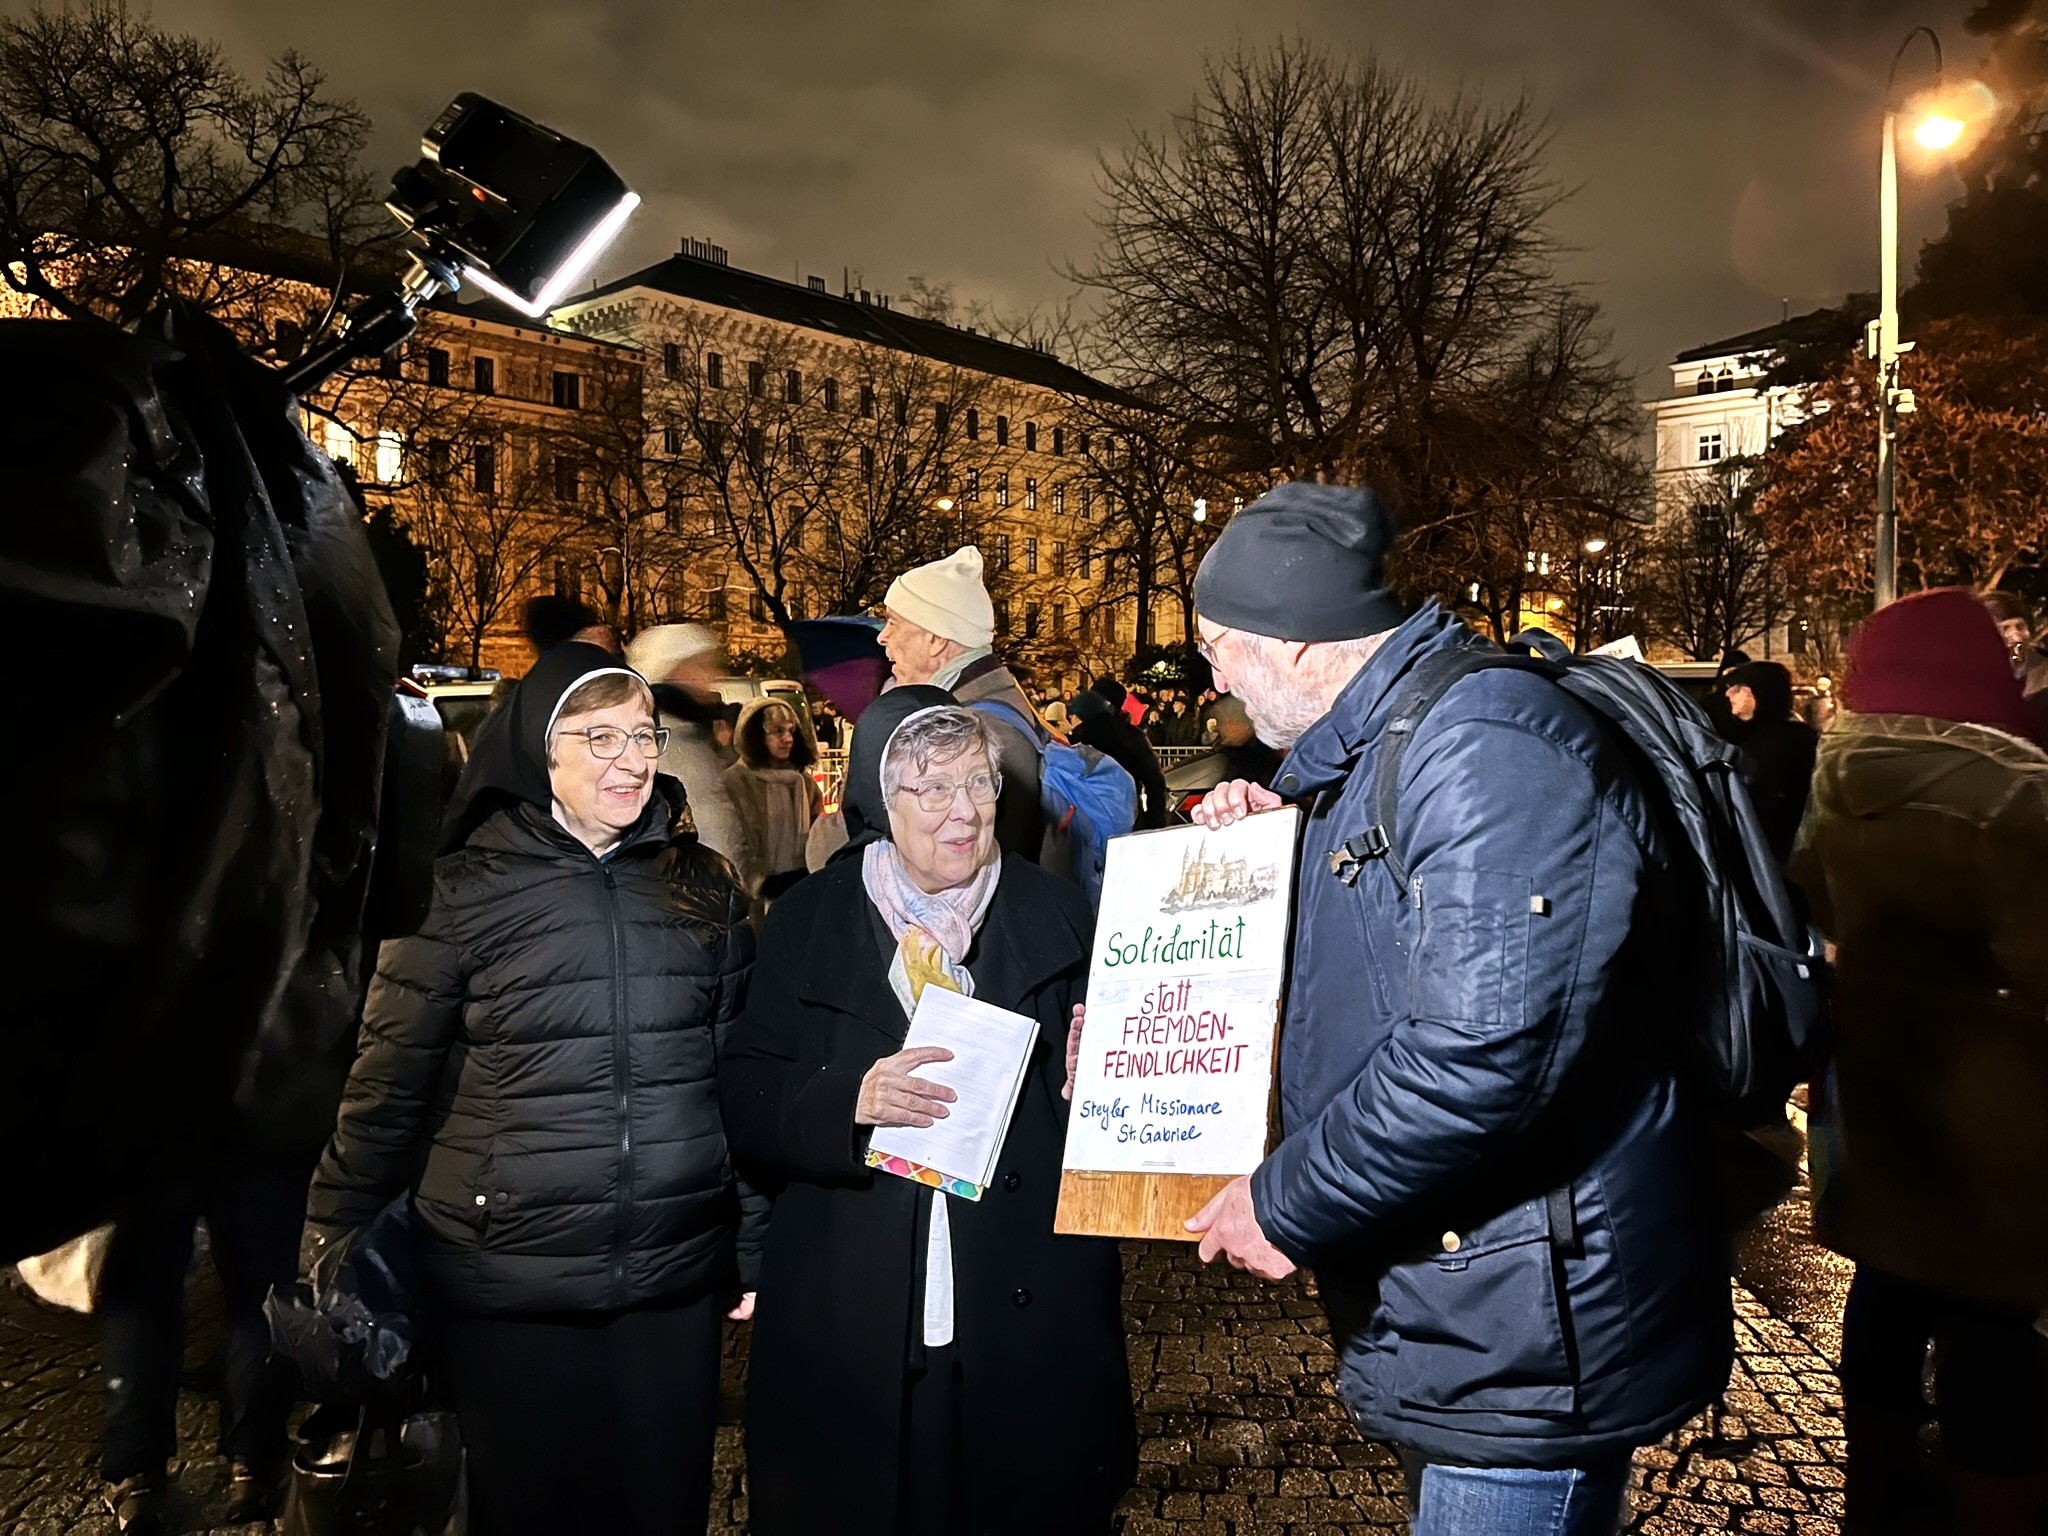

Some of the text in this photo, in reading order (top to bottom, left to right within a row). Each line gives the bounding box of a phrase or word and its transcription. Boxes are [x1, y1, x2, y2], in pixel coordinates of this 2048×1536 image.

[1104, 915, 1246, 967] Solidarität
[1141, 978, 1192, 1015] statt
[1122, 1010, 1234, 1045] FREMDEN-
[1104, 1044, 1249, 1078] FEINDLICHKEIT
[1080, 1092, 1223, 1131] Steyler Missionare
